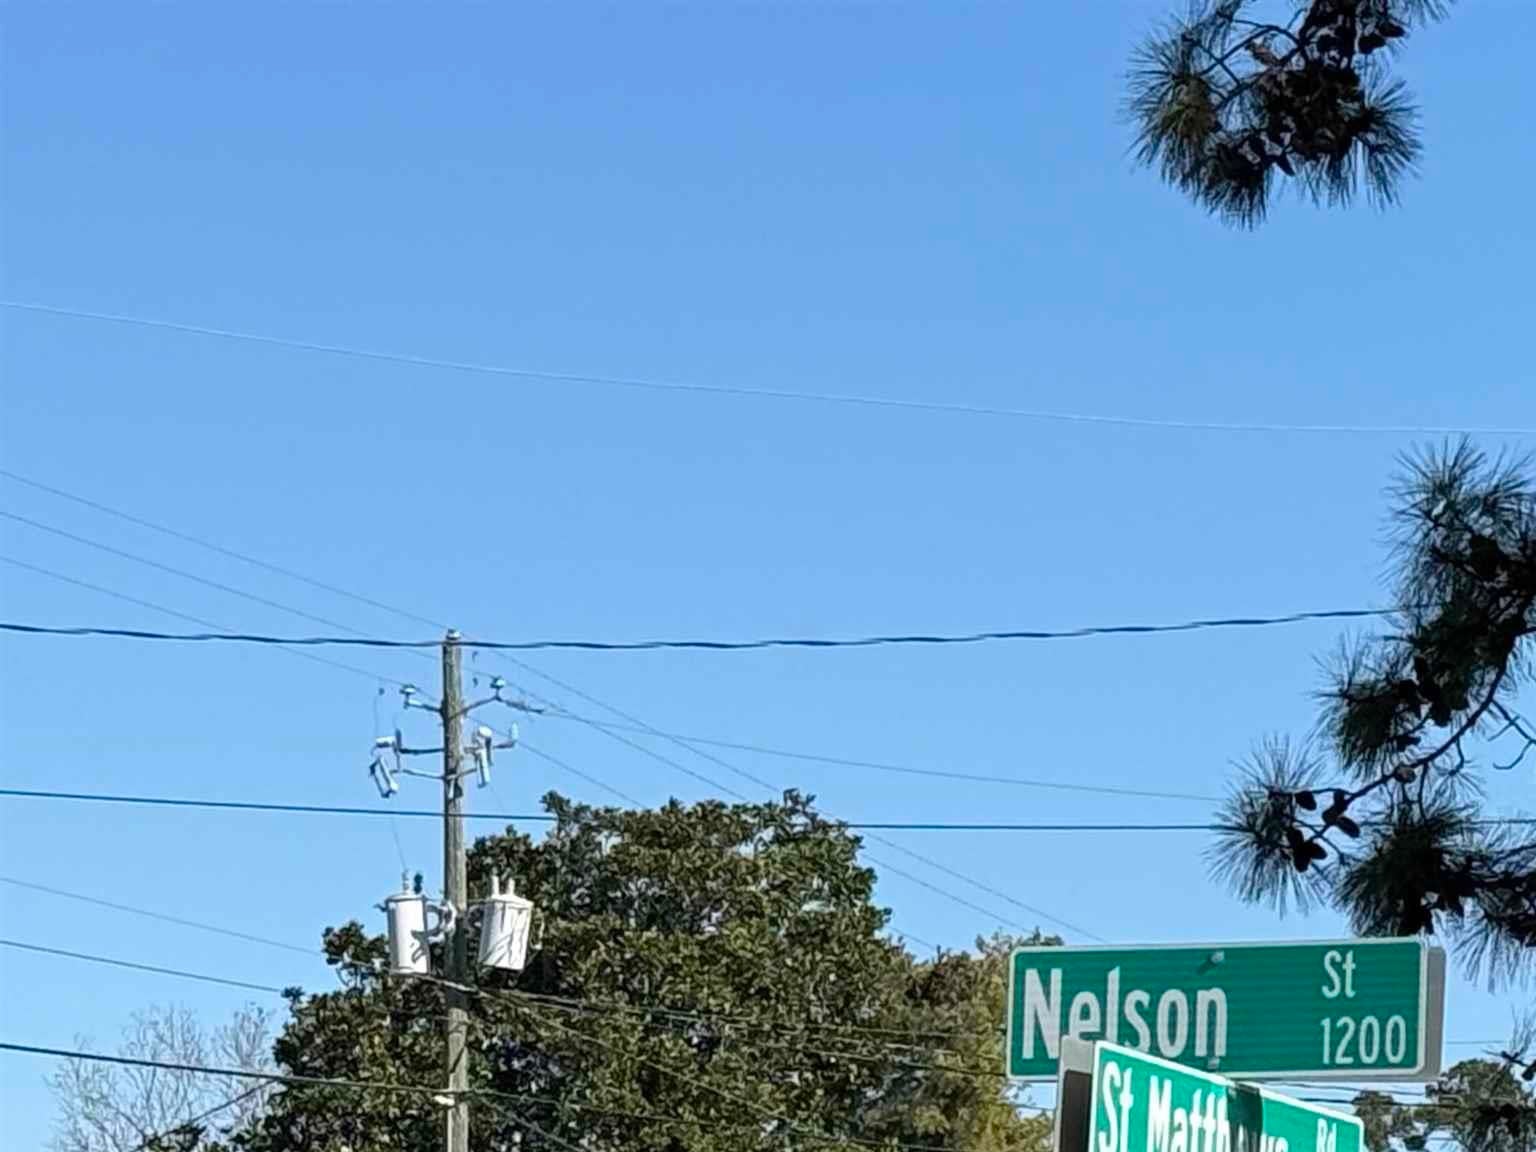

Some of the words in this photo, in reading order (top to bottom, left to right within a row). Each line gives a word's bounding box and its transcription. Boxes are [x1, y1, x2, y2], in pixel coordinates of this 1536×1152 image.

[1322, 950, 1356, 998] St
[1021, 966, 1228, 1059] Nelson
[1321, 1015, 1406, 1064] 1200
